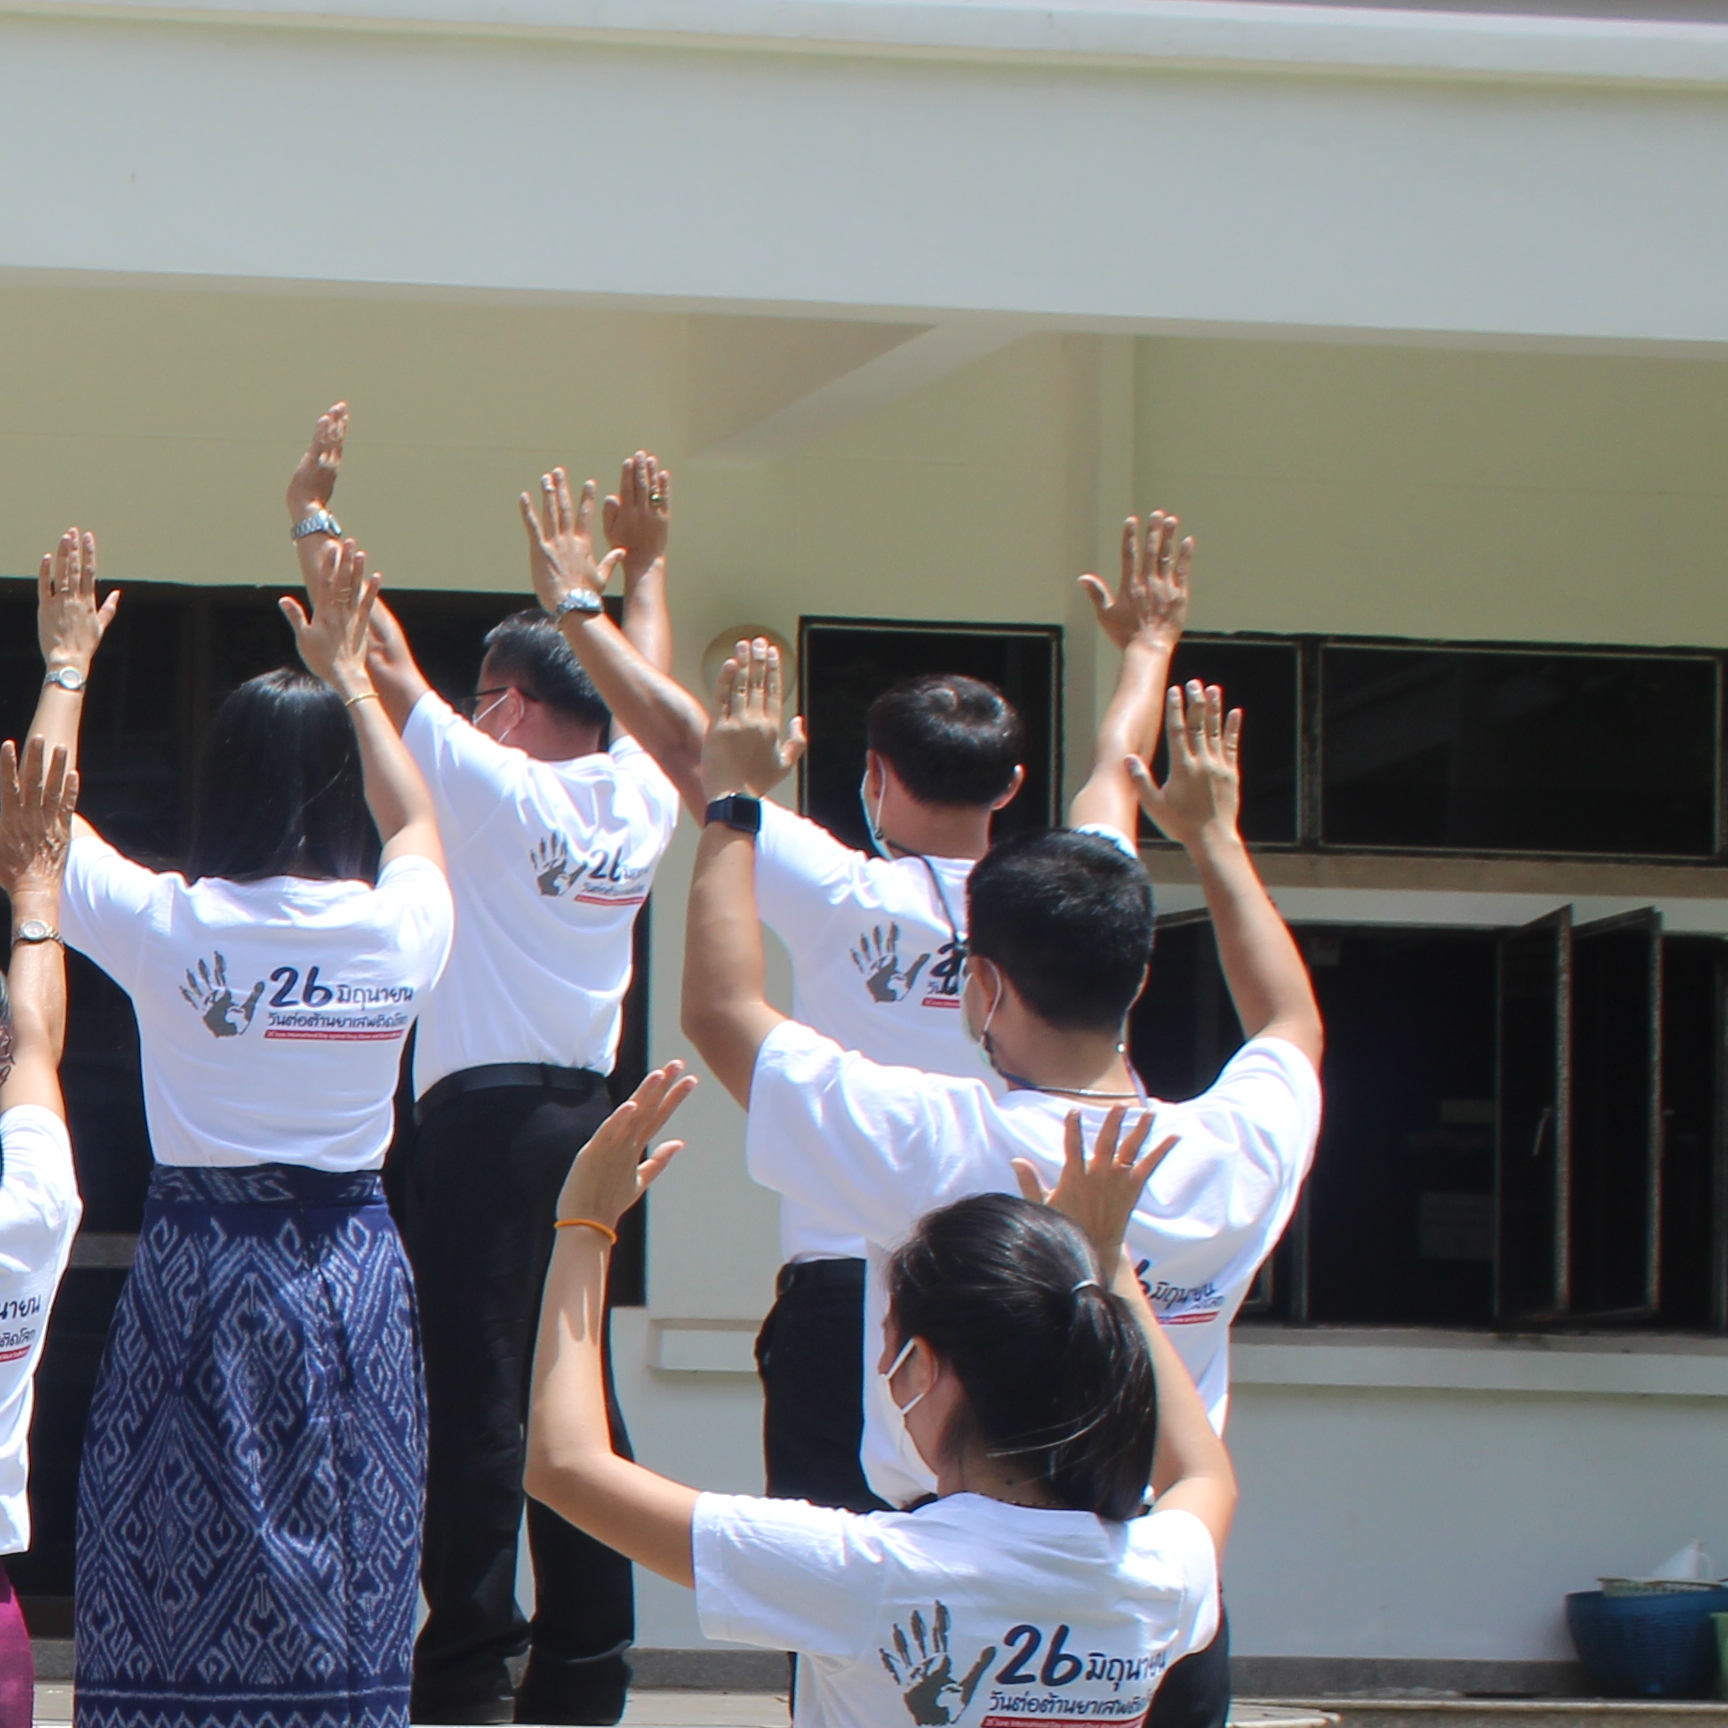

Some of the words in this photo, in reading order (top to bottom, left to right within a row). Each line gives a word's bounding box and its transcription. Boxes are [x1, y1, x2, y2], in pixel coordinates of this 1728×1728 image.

[268, 965, 333, 1008] 26
[336, 984, 414, 1011] มิถุนายน
[995, 1624, 1083, 1686] 26
